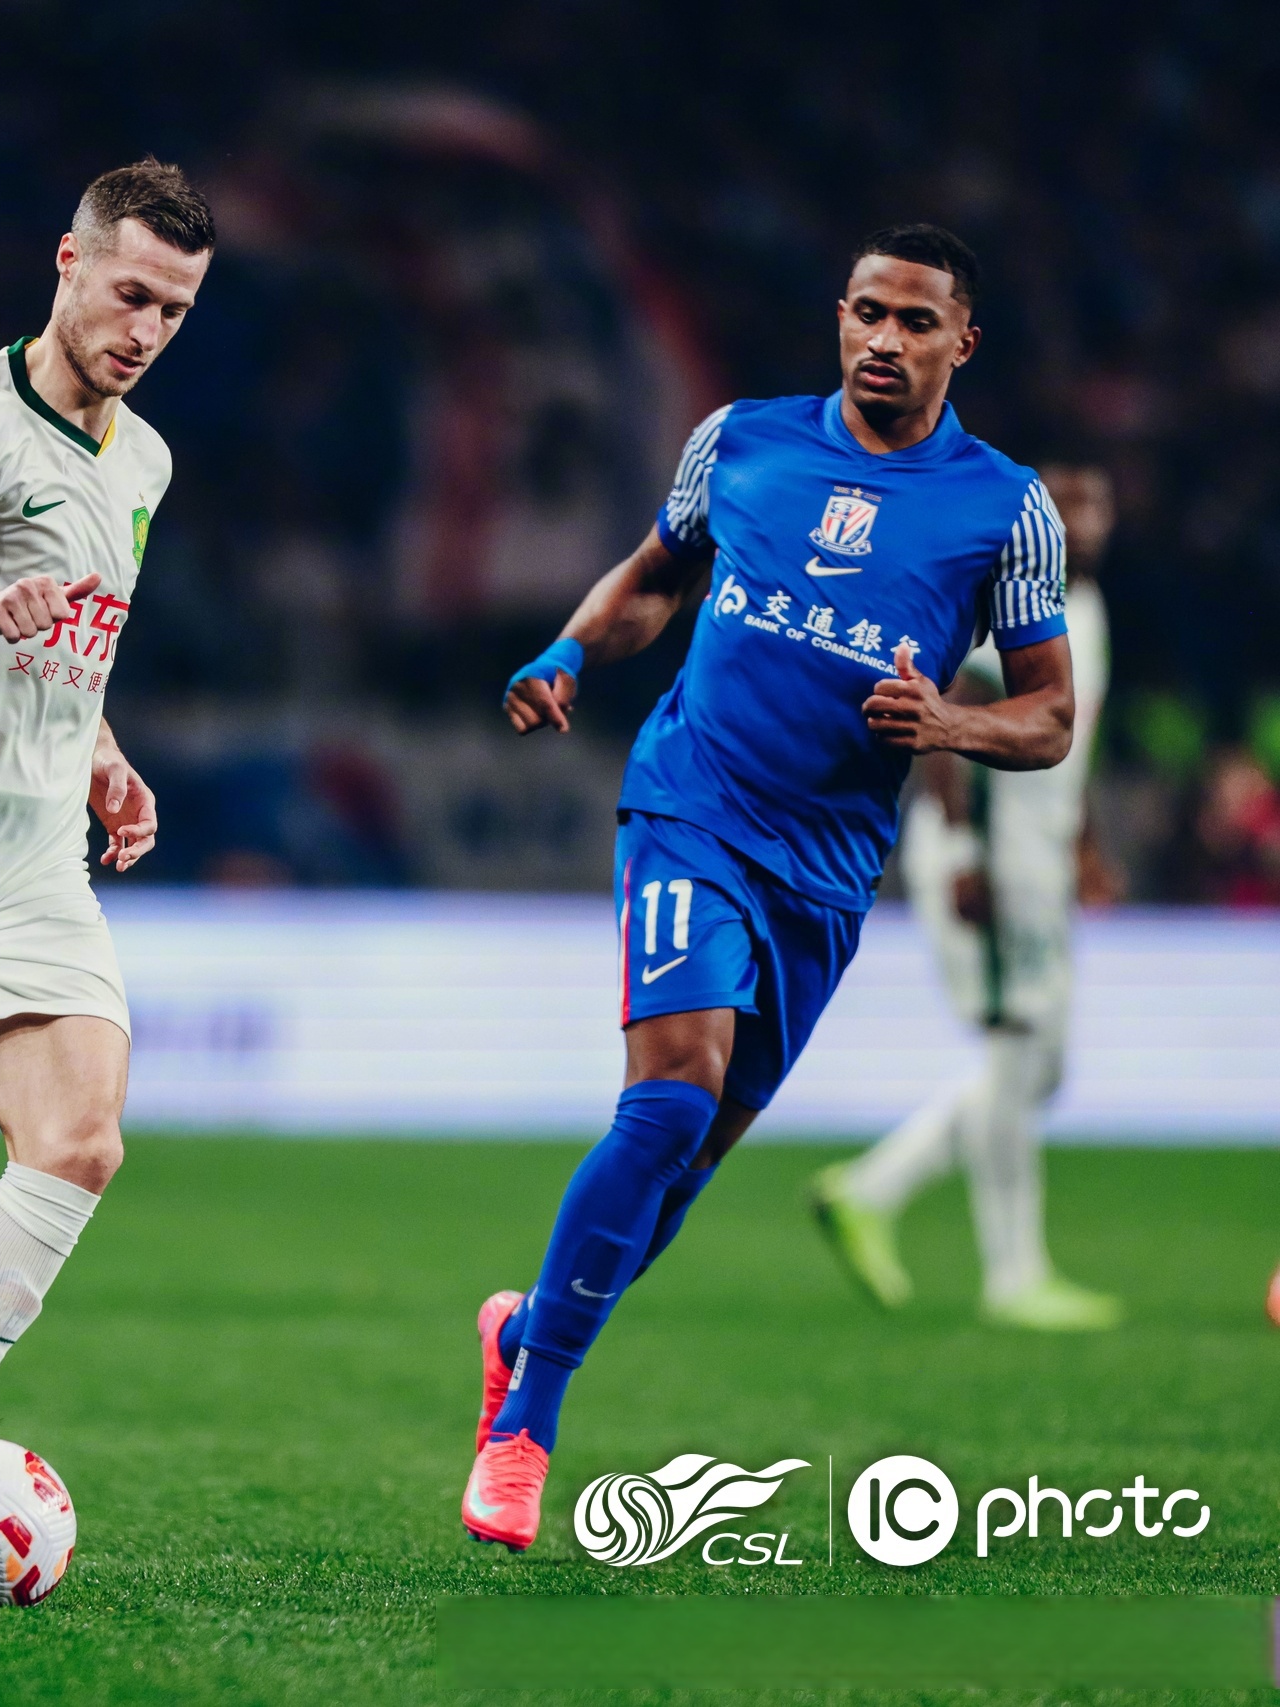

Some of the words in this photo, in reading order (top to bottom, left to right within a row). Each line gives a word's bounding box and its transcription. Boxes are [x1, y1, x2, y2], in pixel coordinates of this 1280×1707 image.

[743, 613, 781, 635] BANK
[785, 627, 807, 642] OF
[9, 651, 109, 694] 又好又便
[641, 878, 694, 956] 11
